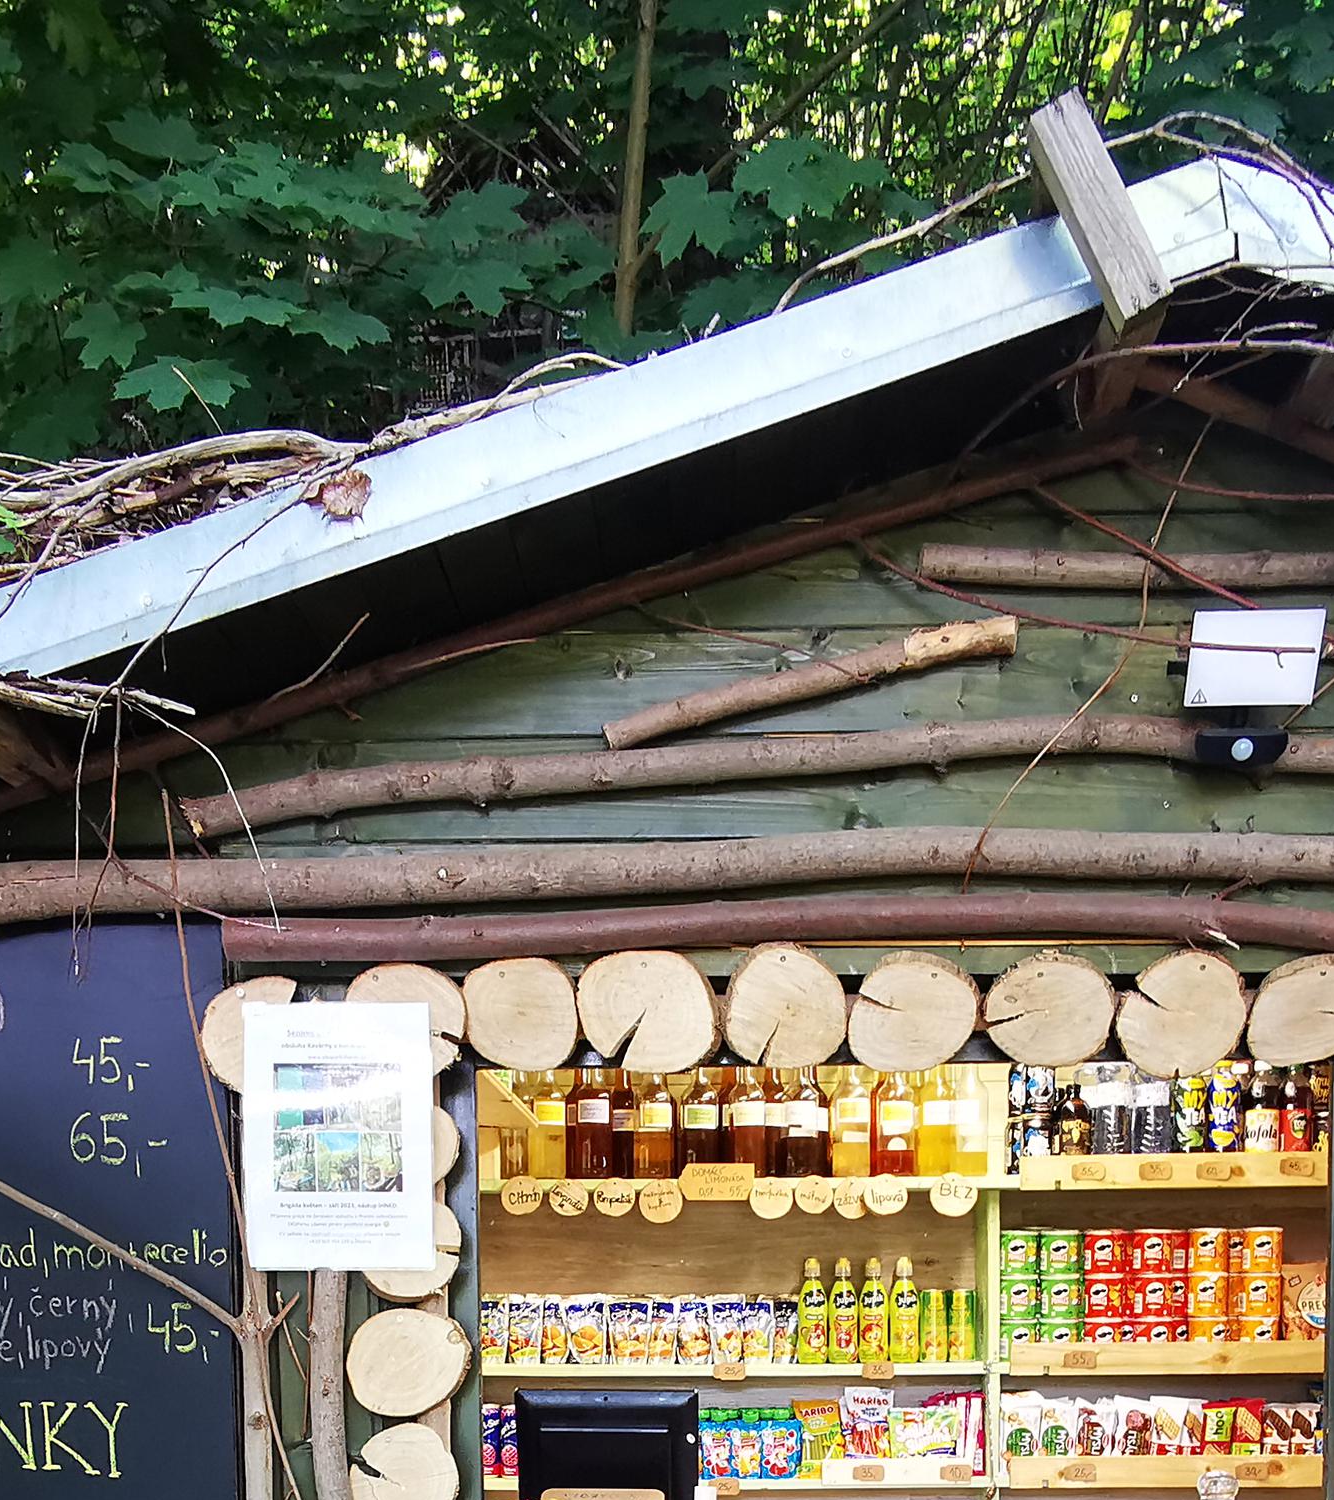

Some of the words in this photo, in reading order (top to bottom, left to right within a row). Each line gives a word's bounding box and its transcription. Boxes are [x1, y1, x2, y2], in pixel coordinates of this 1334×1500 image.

[71, 1036, 150, 1092] 45,-
[1184, 1090, 1207, 1110] MY
[1213, 1090, 1238, 1110] MY
[70, 1112, 166, 1177] 65,-
[939, 1182, 973, 1200] BEZ
[853, 1397, 889, 1406] HARIBO
